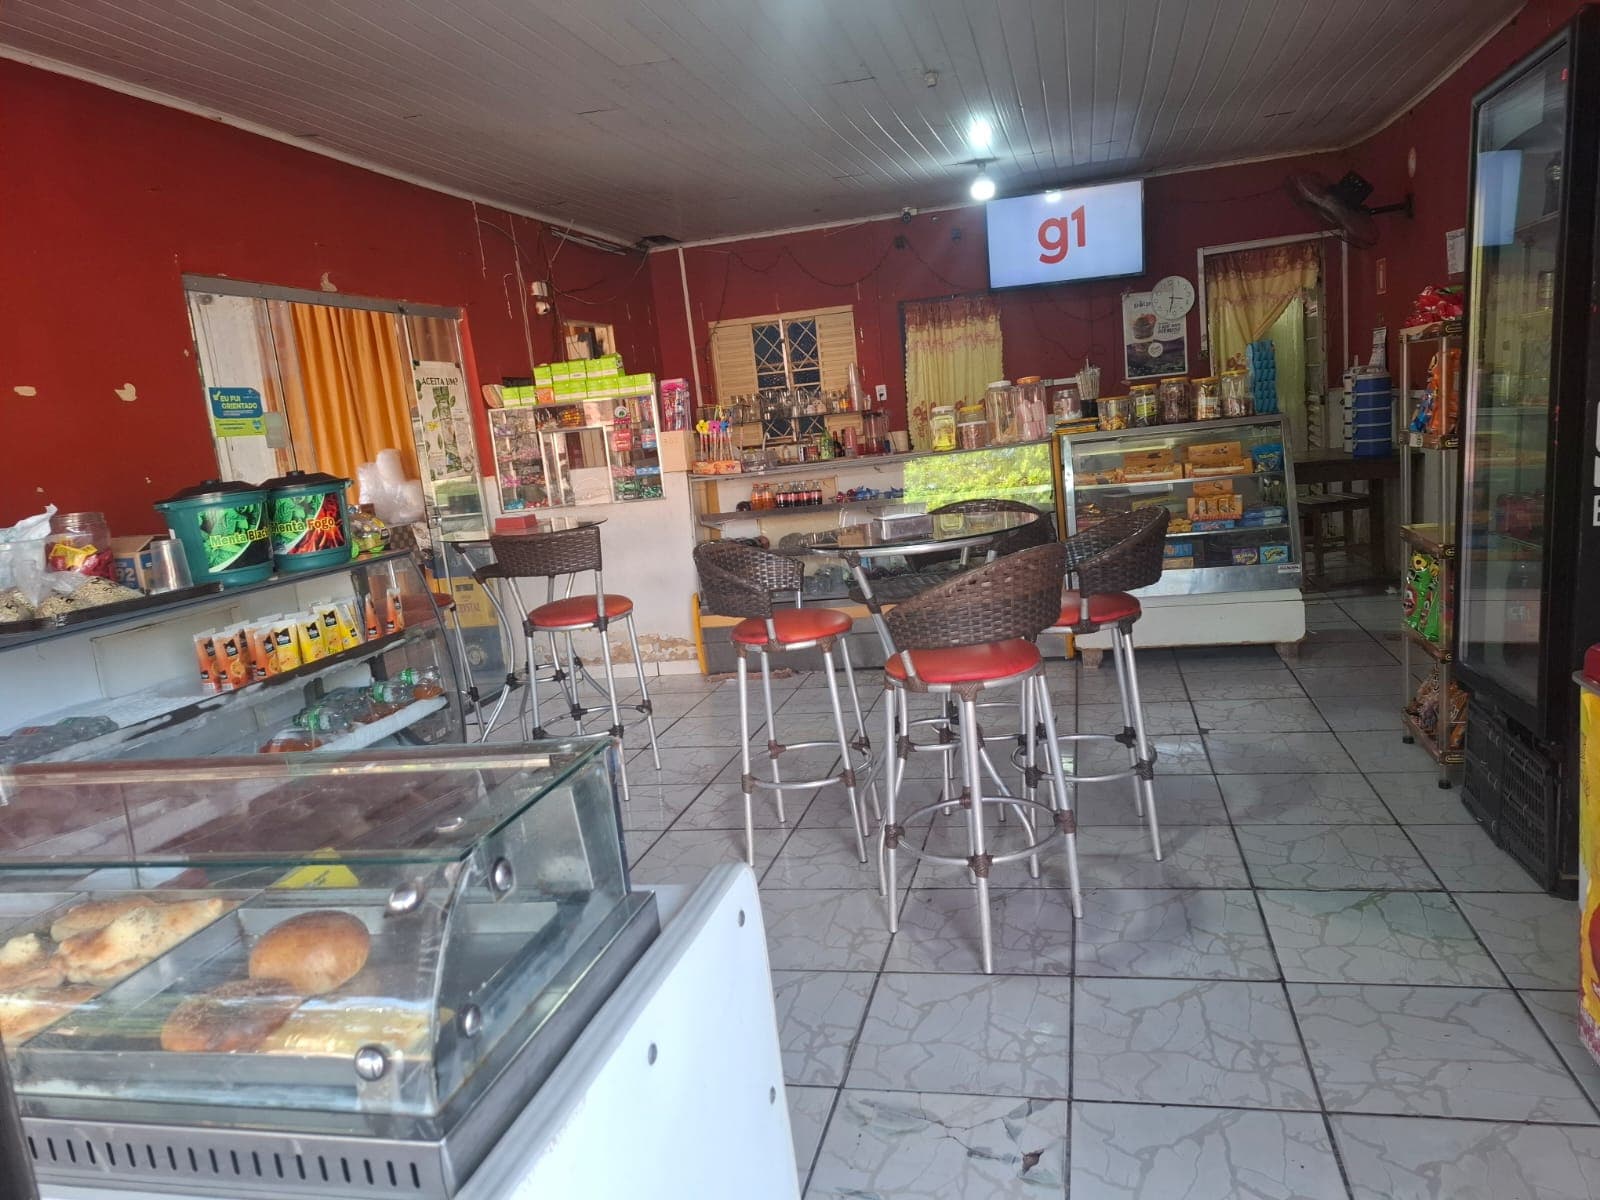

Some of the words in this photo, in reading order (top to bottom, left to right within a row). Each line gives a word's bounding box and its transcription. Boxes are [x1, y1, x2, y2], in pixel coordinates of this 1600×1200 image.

[1037, 204, 1087, 265] g1
[221, 402, 258, 410] ORIENTADO
[270, 520, 305, 534] Menta
[306, 517, 335, 531] Fogo
[209, 533, 247, 548] Menta
